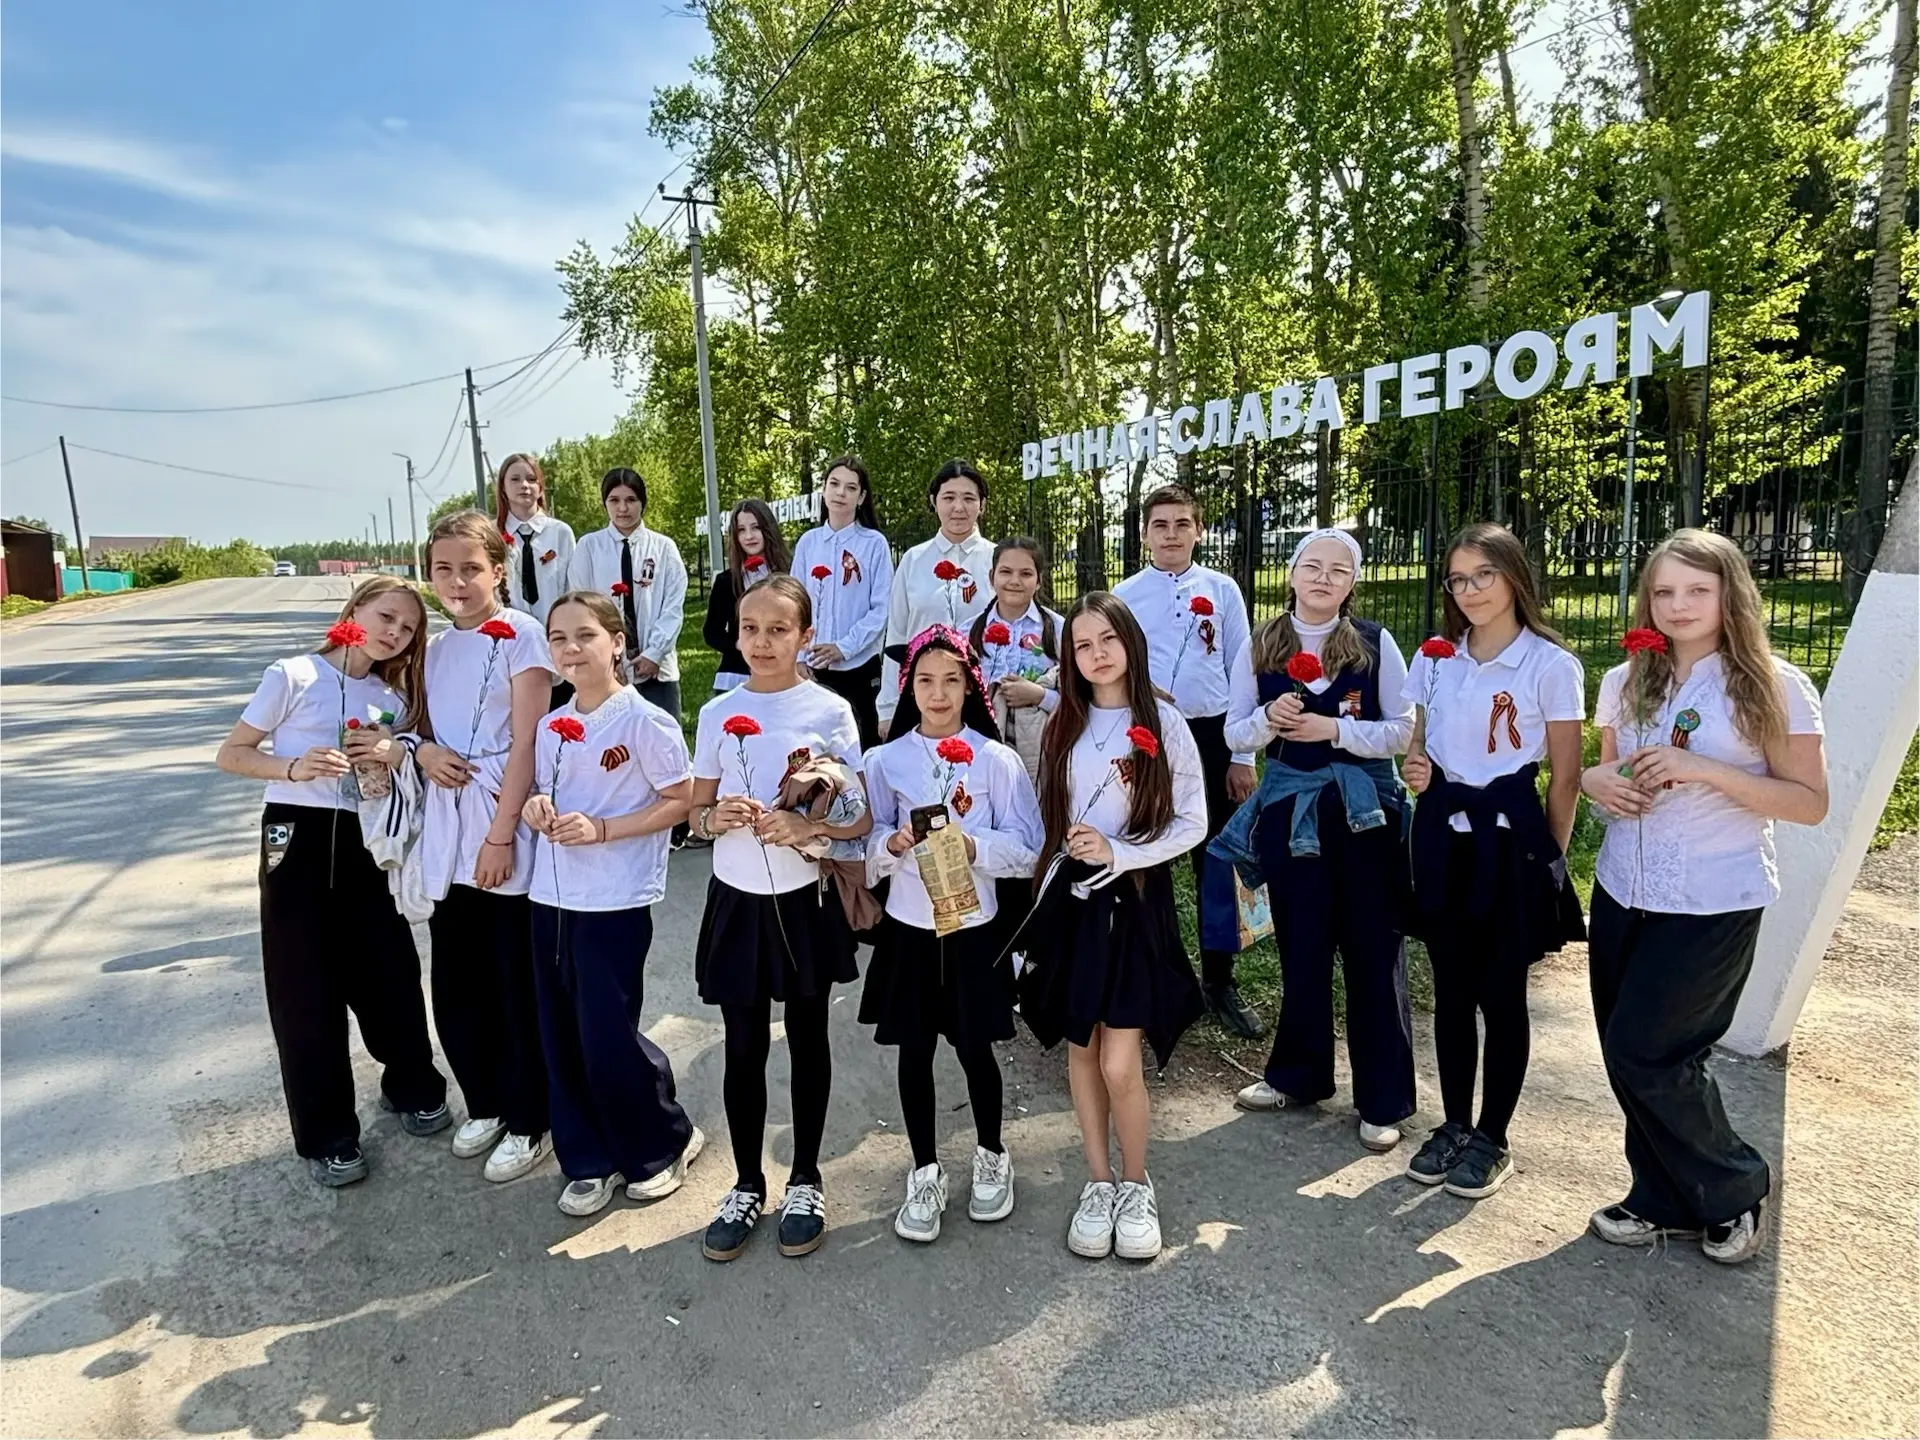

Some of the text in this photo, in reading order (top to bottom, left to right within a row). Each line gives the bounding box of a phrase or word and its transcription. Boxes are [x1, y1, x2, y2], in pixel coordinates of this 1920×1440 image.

[1022, 290, 1711, 481] ВЕЧНАЯ СЛАВА ГЕРОЯМ
